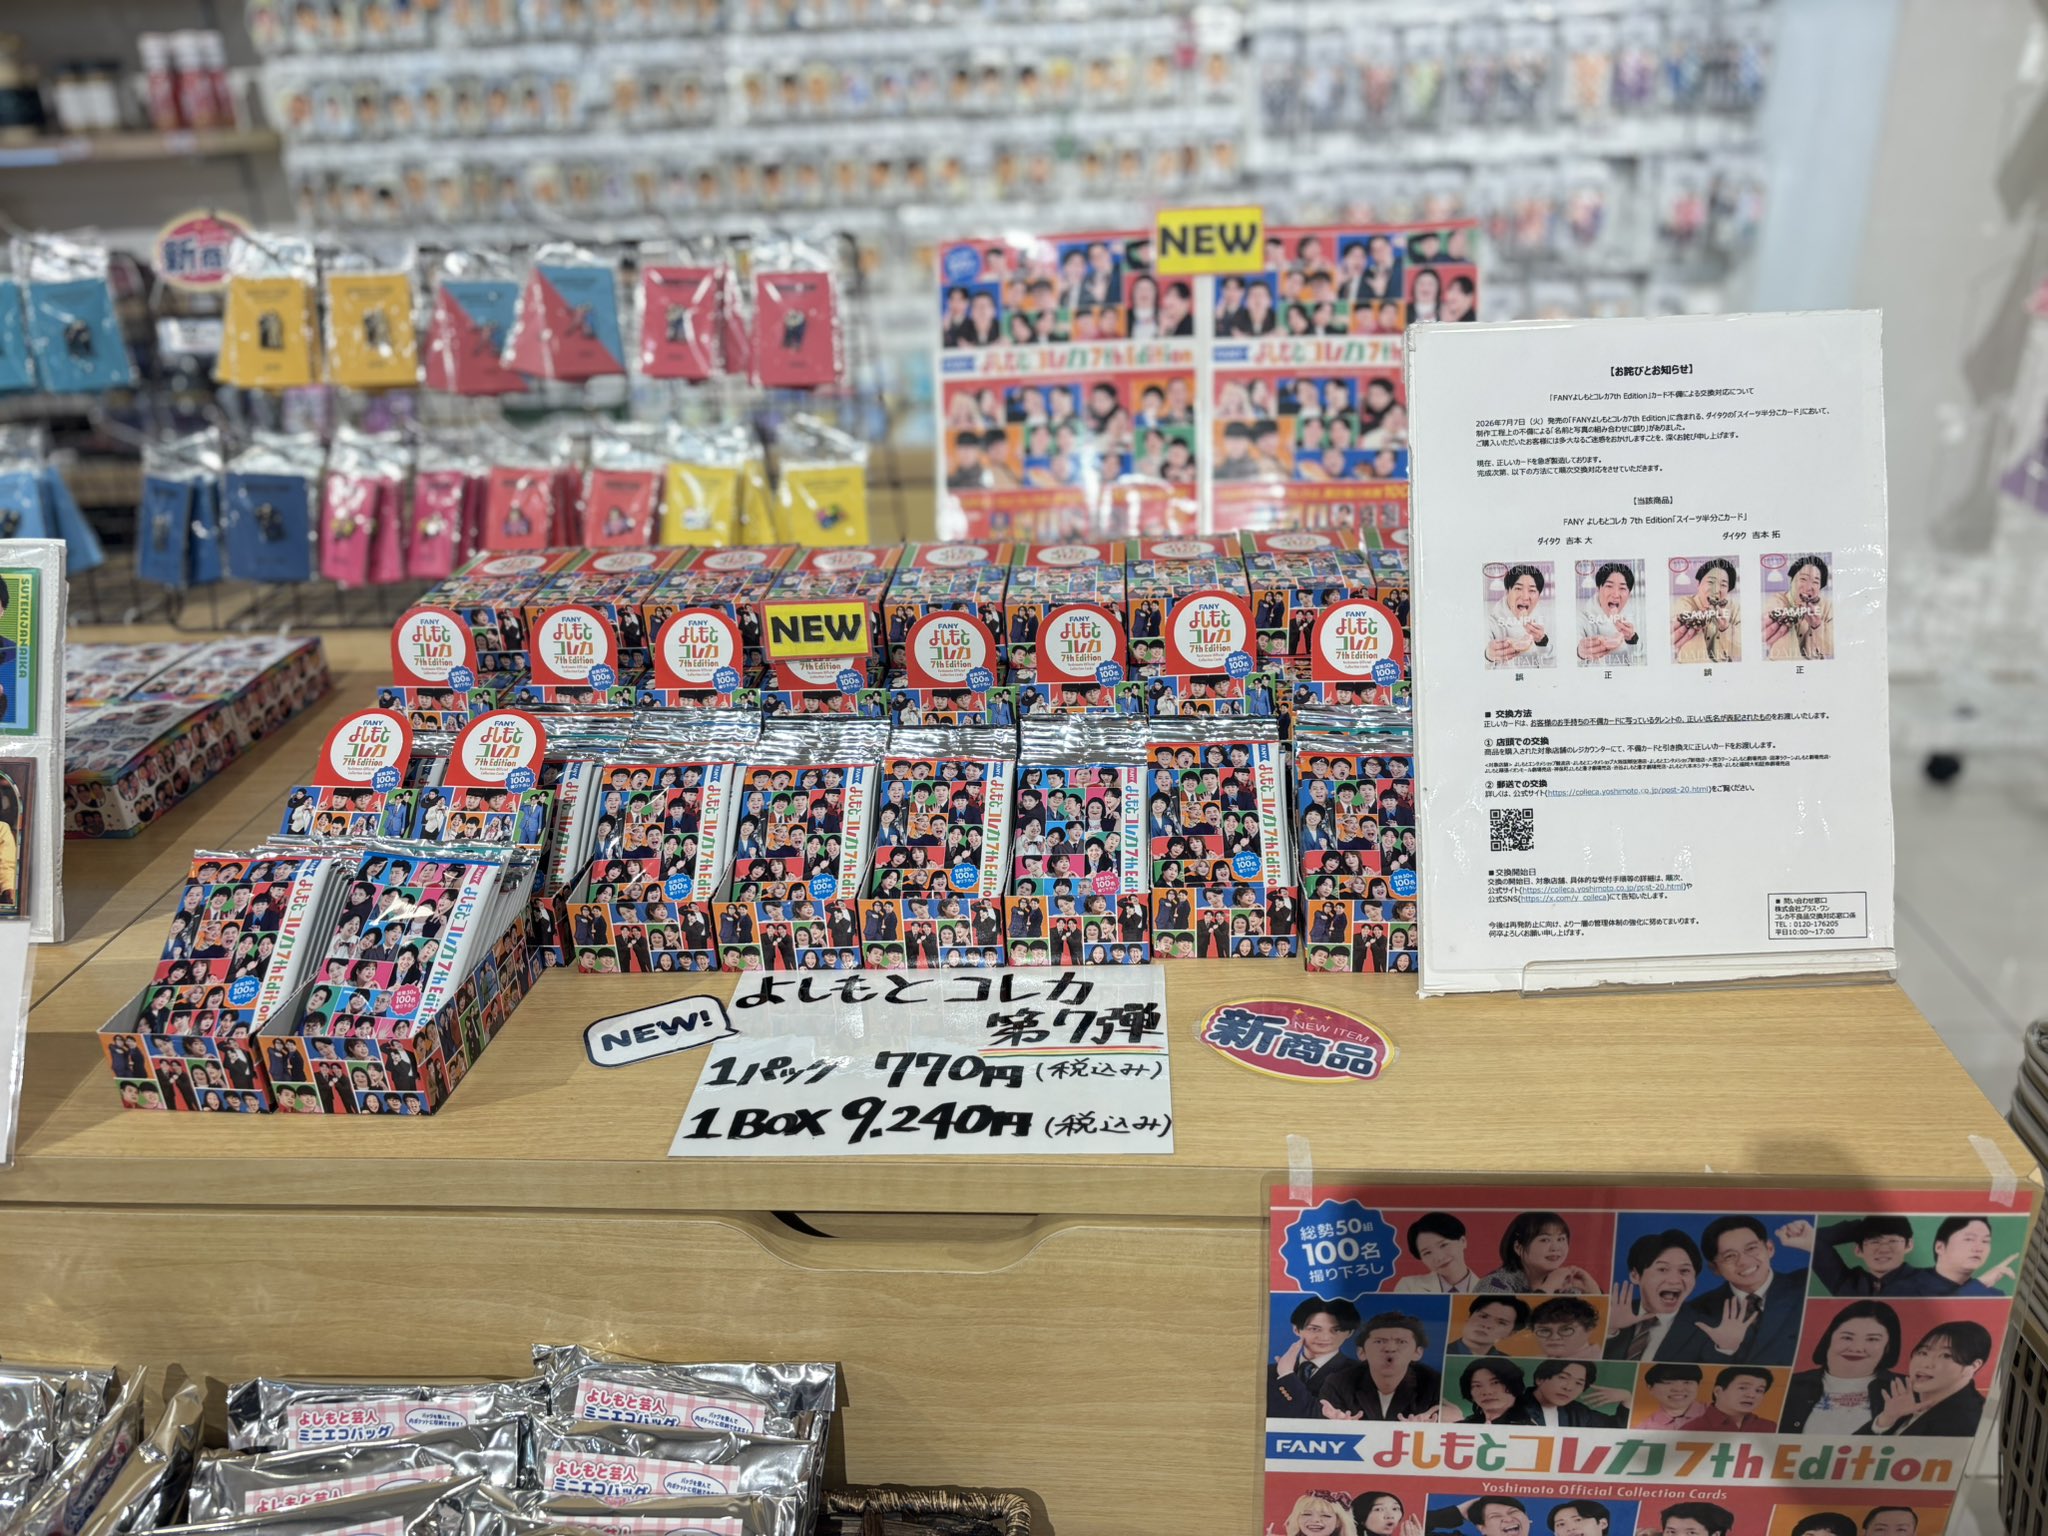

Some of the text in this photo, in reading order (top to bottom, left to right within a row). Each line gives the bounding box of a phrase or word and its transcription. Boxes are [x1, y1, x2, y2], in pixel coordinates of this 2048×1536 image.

[1158, 222, 1258, 257] NEW
[1610, 363, 1693, 377] 【お詫びとお知らせ】
[1476, 456, 1602, 467] 現在、正しいカードを急ぎ製造しております。
[1476, 465, 1664, 477] 完成次第、以下の方法にて順次交換対応をさせていただきます。
[1633, 496, 1674, 505] 【当該商品】
[1563, 518, 1585, 526] FANY
[1587, 517, 1627, 526] よしもとコレカ
[1630, 516, 1643, 525] 7th
[1537, 537, 1561, 546] ダイタク
[1585, 536, 1593, 545] 大
[1722, 531, 1747, 540] ダイタク
[1189, 609, 1231, 628] よしもと
[1682, 608, 1731, 620] SAMPLE
[1775, 606, 1822, 617] SAMPLE
[18, 578, 30, 678] SUTEKIJANAIKA
[412, 623, 451, 643] よしもと
[553, 622, 593, 641] よしもと
[770, 613, 863, 645] NEW
[1060, 621, 1101, 639] よしもと
[1335, 617, 1378, 635] よしもと
[678, 626, 718, 644] よしもと
[929, 628, 971, 646] よしもと
[1189, 629, 1231, 644] コレカ
[412, 643, 452, 657] コレカ
[553, 641, 594, 656] コレカ
[1060, 640, 1101, 653] コレカ
[1189, 644, 1231, 653] 7th Edition
[1335, 636, 1378, 651] コレカ
[678, 644, 719, 659] コレカ
[929, 646, 972, 660] コレカ
[1061, 653, 1102, 662] 7th Edition
[1336, 651, 1378, 660] 7th Edition
[414, 657, 453, 666] 7th Edition
[554, 655, 594, 665] 7th Edition
[678, 659, 719, 668] 7th Edition
[800, 661, 841, 670] 7th Edition
[930, 660, 972, 669] 7th Edition
[1604, 671, 1612, 679] 正
[1796, 666, 1804, 674] 正
[1495, 709, 1533, 718] 交換方法
[348, 725, 391, 743] よしもと
[480, 726, 524, 744] よしもと
[1496, 737, 1549, 746] 店頭での交換
[343, 743, 388, 758] コレカ
[476, 744, 520, 758] コレカ
[342, 757, 383, 766] 7th Edition
[474, 757, 517, 767] 7th Edition
[1497, 779, 1548, 789] 郵送での交換
[1495, 868, 1537, 876] 交換開始日
[1488, 928, 1585, 938] 何卒よろしくお願い申し上げます。
[600, 1009, 714, 1052] NEW!
[986, 1002, 1165, 1046] 第7弾
[1294, 1020, 1370, 1044] NEW ITEM
[1207, 1008, 1377, 1076] 新商品
[875, 1050, 1025, 1088] 770円
[1299, 1218, 1374, 1242] 総勢50組
[1301, 1237, 1381, 1267] 100名
[1308, 1262, 1385, 1284] 撮り下ろし
[584, 1388, 667, 1414] よしもと芸人
[299, 1408, 379, 1426] よしもと芸人
[583, 1406, 680, 1427] ミニエコバッグ
[298, 1425, 392, 1442] ミニエコバッグ
[1275, 1439, 1347, 1455] FANY
[1674, 1441, 1762, 1479] 7th
[1770, 1444, 1953, 1483] Edition
[554, 1460, 638, 1482] よしもと芸人
[553, 1477, 650, 1496] ミニエコバッグ
[1481, 1481, 1728, 1500] Yoshimoto Official Collection Cards
